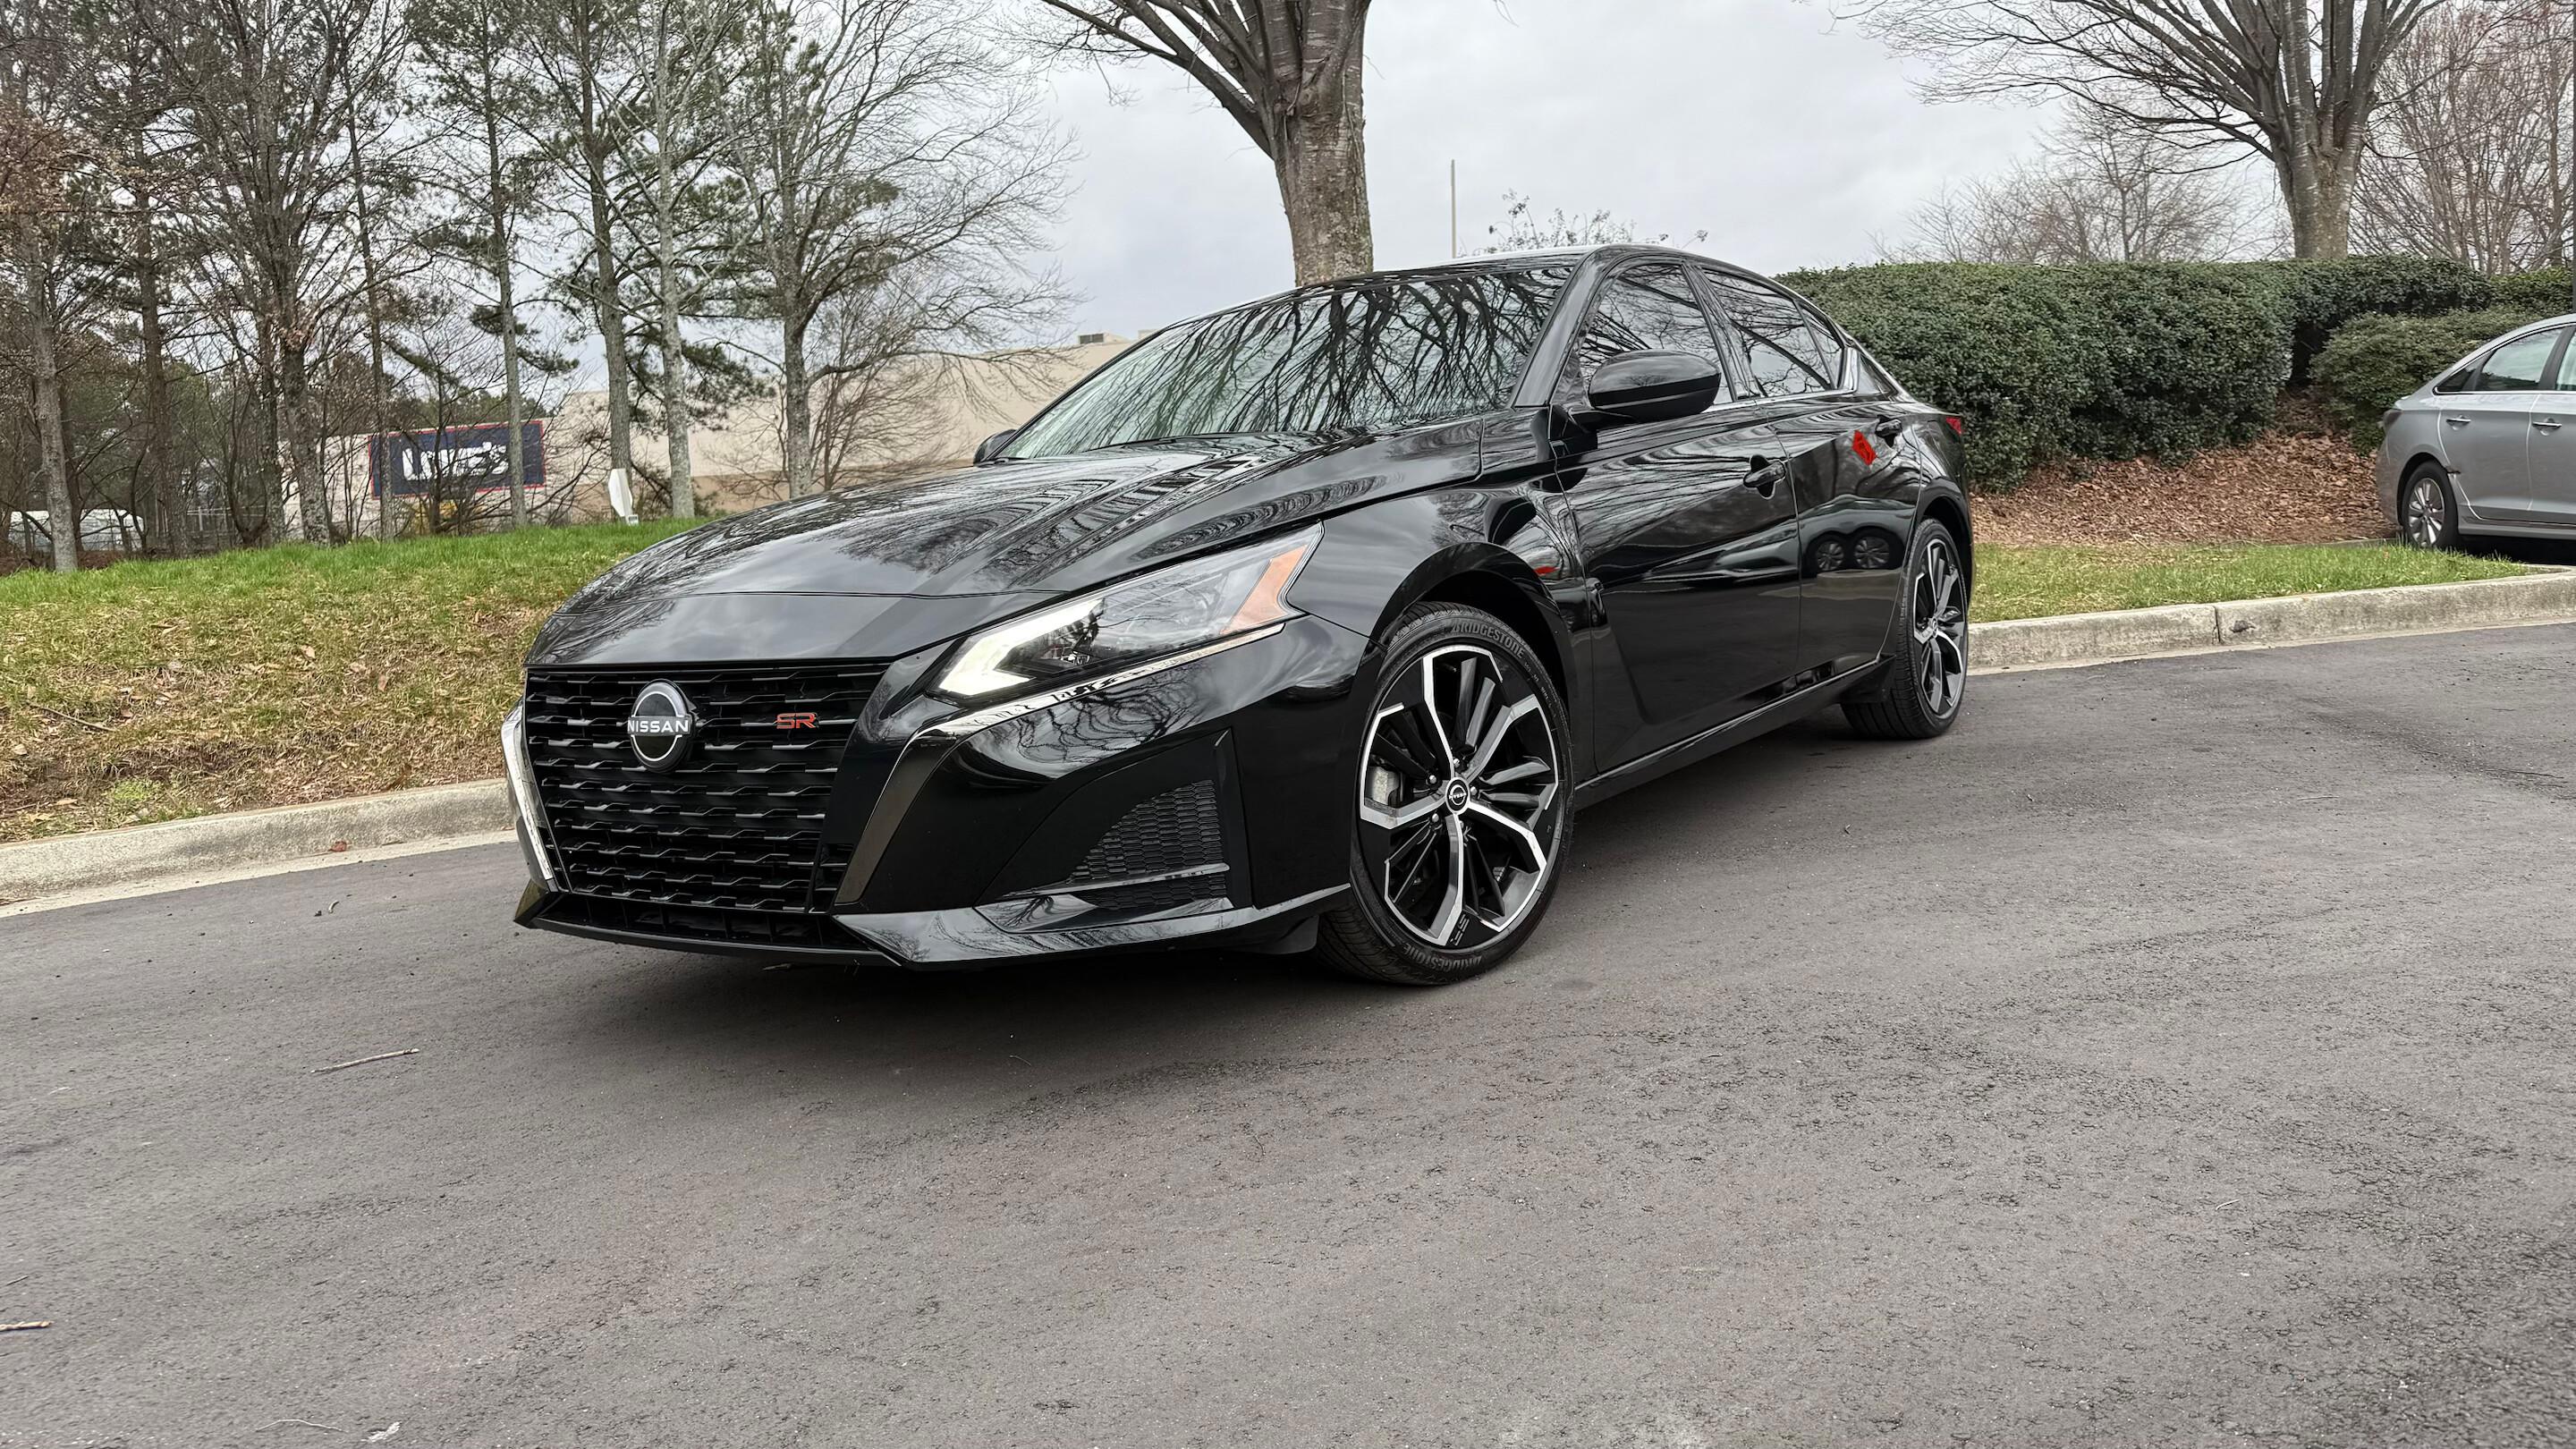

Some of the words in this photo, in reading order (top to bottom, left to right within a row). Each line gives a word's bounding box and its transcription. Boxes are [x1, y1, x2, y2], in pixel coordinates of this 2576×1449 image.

[1451, 619, 1526, 659] BRIDGESTONE
[627, 718, 689, 733] NISSAN
[776, 712, 818, 730] SR
